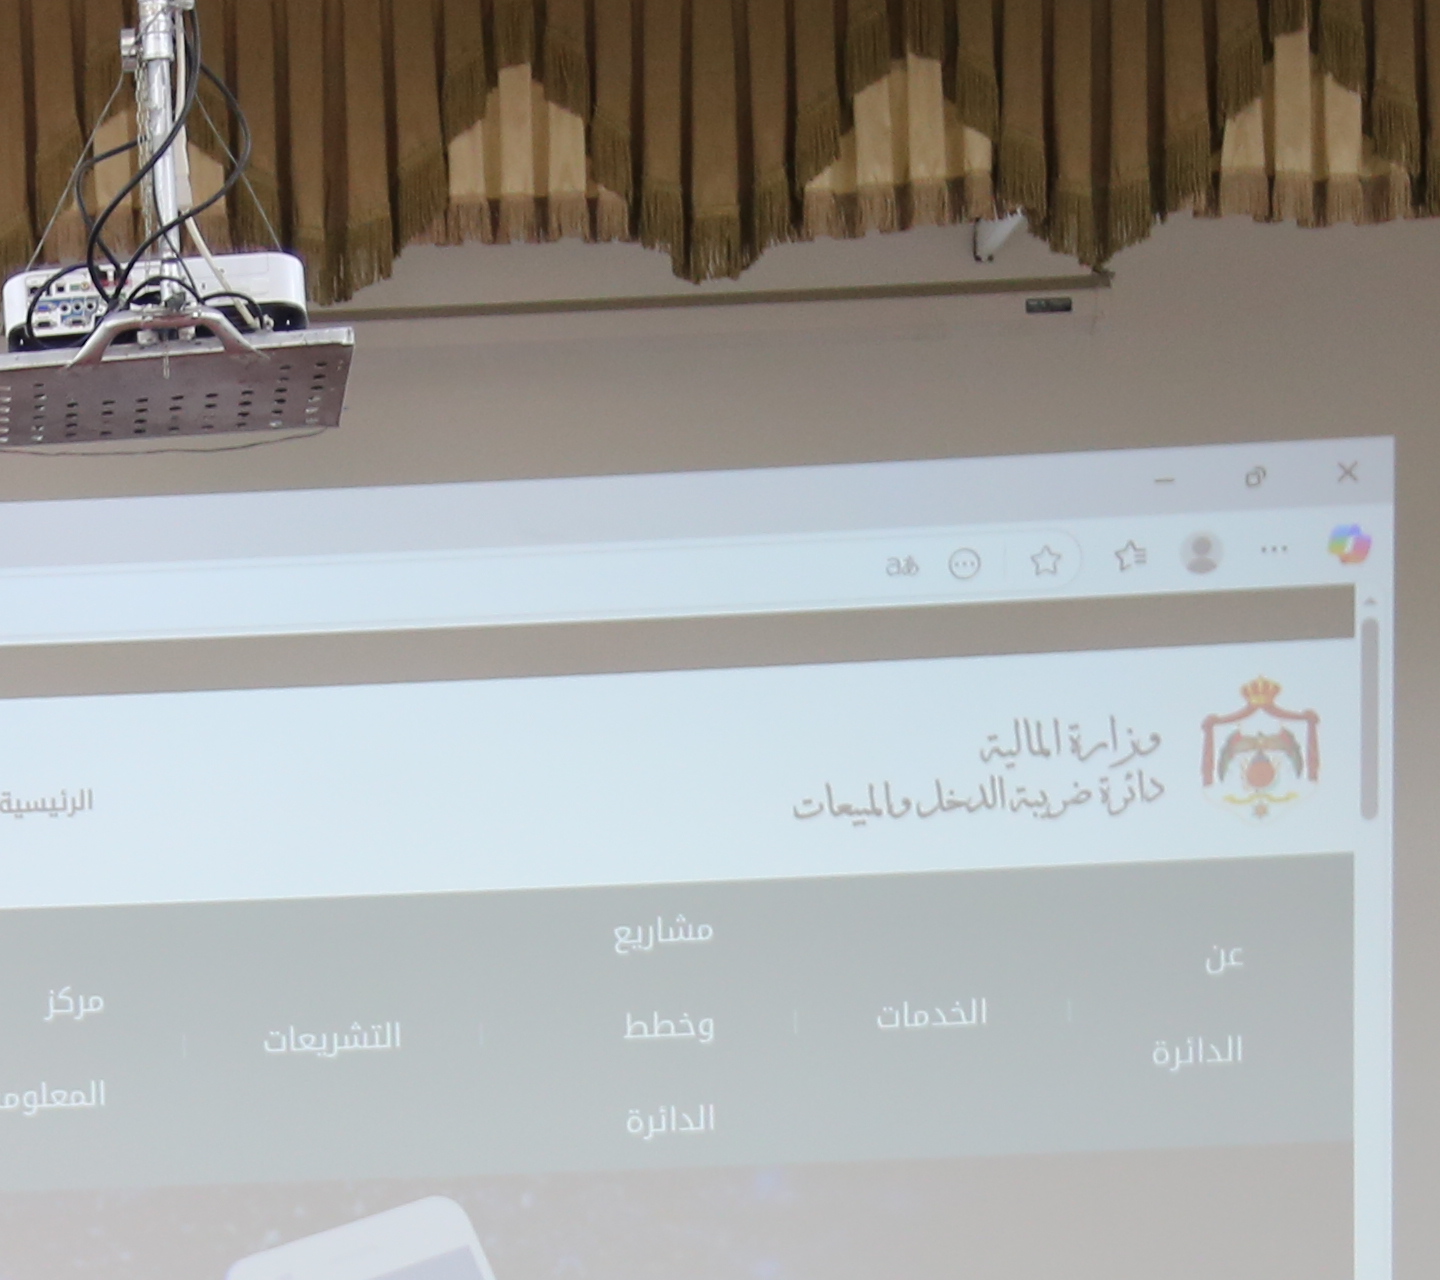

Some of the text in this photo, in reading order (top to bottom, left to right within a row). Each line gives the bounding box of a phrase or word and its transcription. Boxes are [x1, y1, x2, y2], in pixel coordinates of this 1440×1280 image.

[979, 714, 1163, 770] وزارة المالية
[792, 769, 1166, 827] دائرة ضريبة الدخل والمبيعات
[612, 913, 715, 955] مشاريع
[1204, 942, 1246, 975] عن
[42, 985, 106, 1022] مركز
[876, 998, 990, 1033] الخدمات
[262, 1020, 403, 1057] التشريعات
[623, 1010, 717, 1046] وخطط
[1151, 1034, 1246, 1072] الدائرة
[625, 1101, 718, 1142] الدائرة
